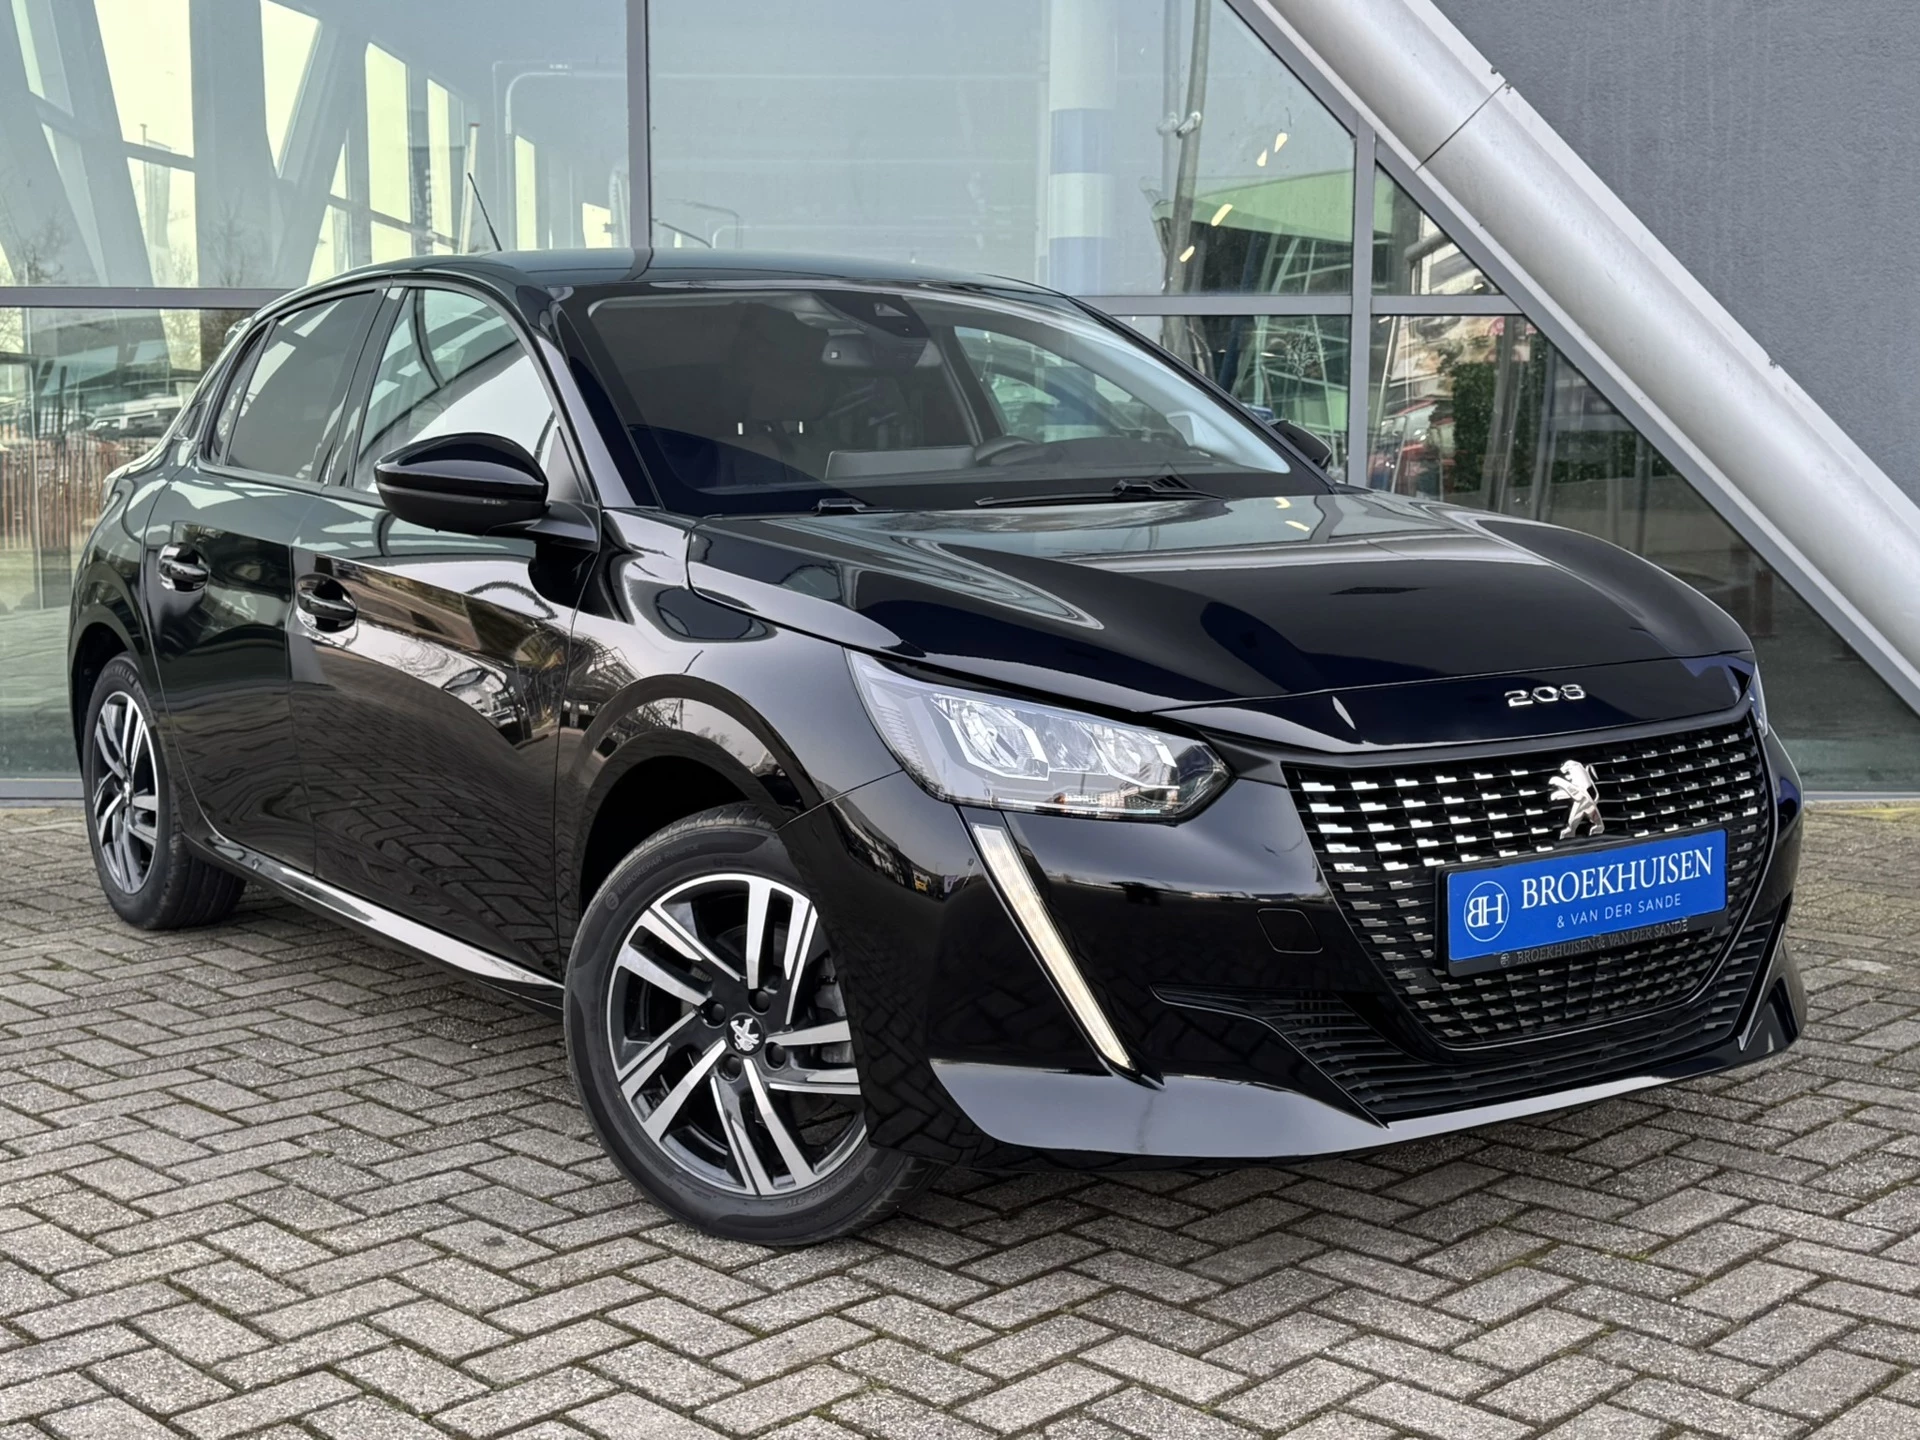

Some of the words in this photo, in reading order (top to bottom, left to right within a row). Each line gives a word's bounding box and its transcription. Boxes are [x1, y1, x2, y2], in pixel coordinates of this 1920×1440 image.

[1504, 684, 1587, 707] 208
[1521, 847, 1713, 909] BROEKHUISEN
[1556, 915, 1565, 928] &
[1570, 909, 1598, 925] VAN
[1605, 903, 1632, 919] DER
[1638, 893, 1681, 913] SANDE
[1516, 937, 1597, 965] BROEKHUISEN
[1597, 935, 1606, 948] &
[1608, 930, 1630, 946] VAN
[1631, 926, 1652, 941] DER
[1652, 918, 1688, 936] SANDE
